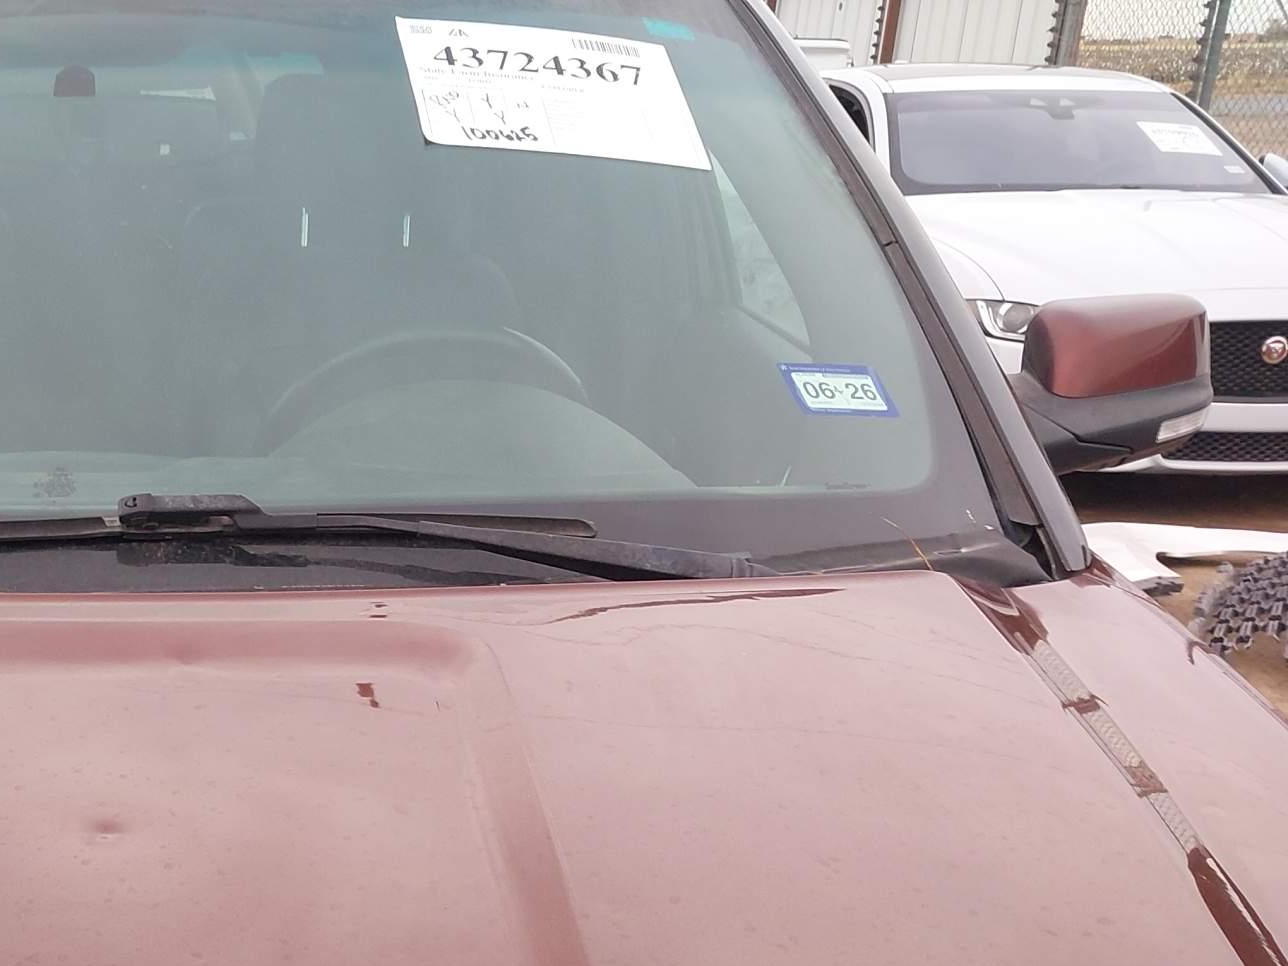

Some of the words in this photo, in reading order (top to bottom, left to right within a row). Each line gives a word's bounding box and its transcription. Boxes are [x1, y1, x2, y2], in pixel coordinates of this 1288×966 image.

[433, 46, 641, 86] 43724367
[803, 381, 836, 400] 06
[845, 383, 878, 401] 26
